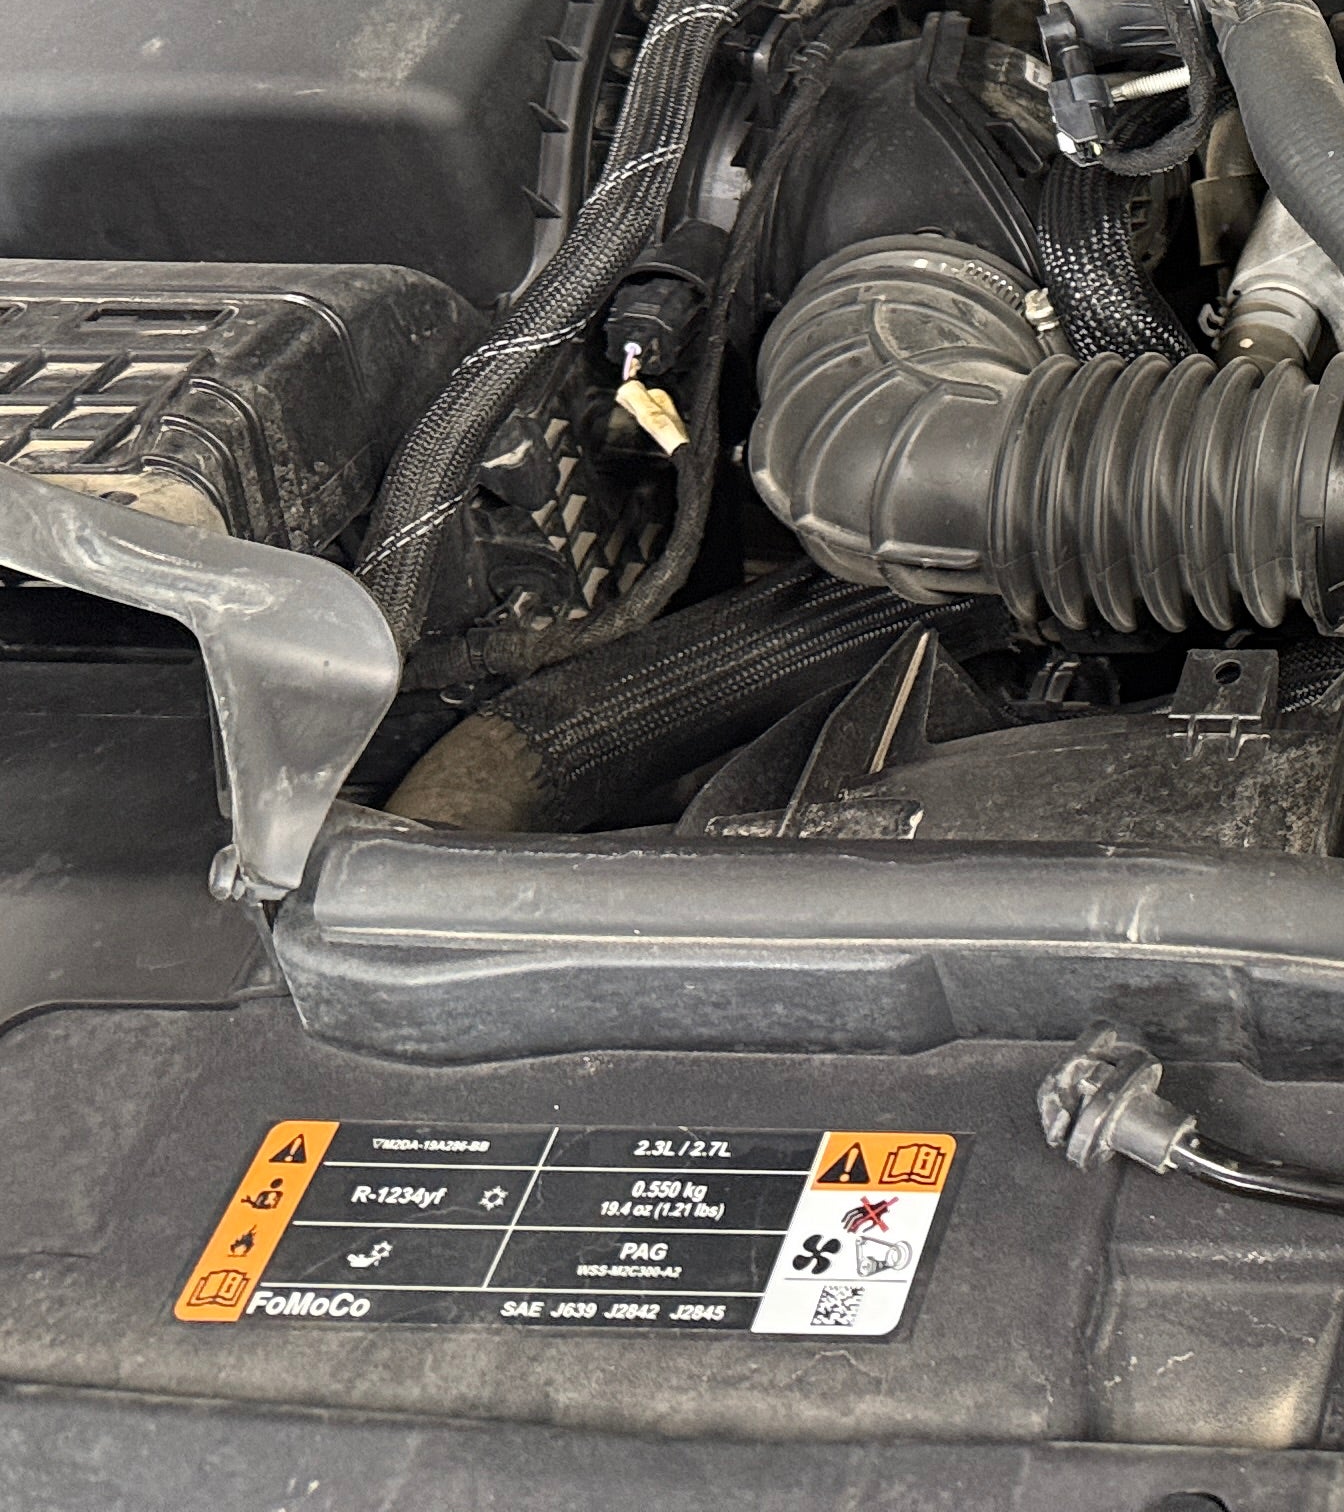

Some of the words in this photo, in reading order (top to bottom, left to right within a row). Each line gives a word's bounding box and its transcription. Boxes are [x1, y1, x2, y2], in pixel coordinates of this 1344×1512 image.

[633, 1140, 676, 1156] 2.3L
[689, 1140, 732, 1158] 2.7L
[350, 1185, 448, 1209] R-1234yf
[631, 1180, 682, 1198] 0.550
[682, 1182, 708, 1203] kg
[600, 1201, 632, 1217] 19.4
[632, 1205, 653, 1217] oz
[653, 1203, 692, 1221] (1.21
[693, 1203, 726, 1222] lbs)
[619, 1242, 669, 1261] PAG
[245, 1290, 371, 1318] FoMoCo
[500, 1300, 545, 1318] SAE
[550, 1302, 598, 1320] J639
[604, 1303, 661, 1321] J2842
[669, 1304, 727, 1322] J2845
